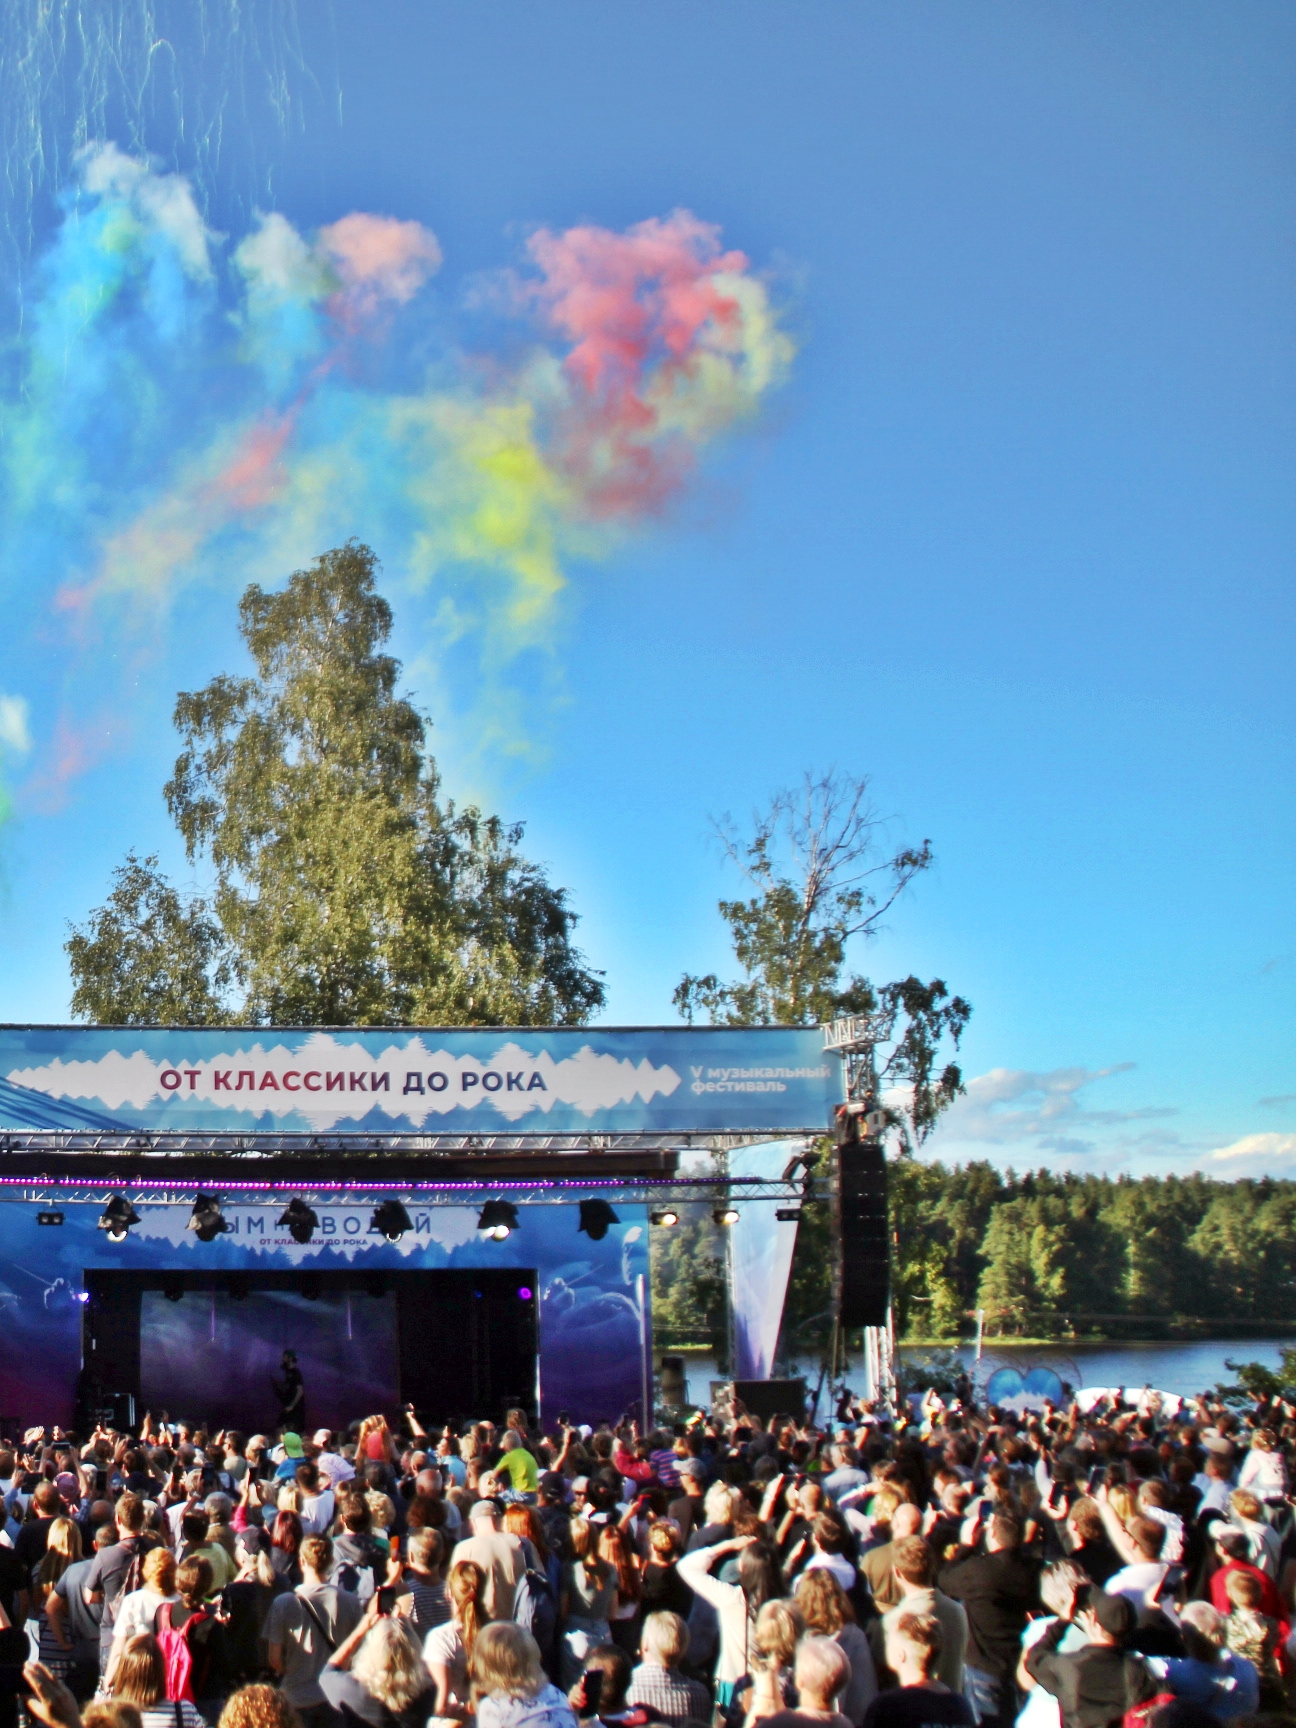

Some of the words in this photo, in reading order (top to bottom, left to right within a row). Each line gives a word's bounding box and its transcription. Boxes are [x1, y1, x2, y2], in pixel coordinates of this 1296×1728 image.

[690, 1065, 704, 1078] V
[708, 1064, 831, 1081] музыкальный
[159, 1069, 202, 1090] ОТ
[213, 1070, 391, 1092] КЛАССИКИ
[402, 1071, 449, 1095] ДО
[461, 1071, 549, 1092] РОКА
[691, 1079, 787, 1095] фестиваль
[223, 1215, 264, 1234] ЫМ
[321, 1213, 431, 1234] ВОЙ
[326, 1238, 341, 1246] ДО
[343, 1238, 368, 1246] РОКА
